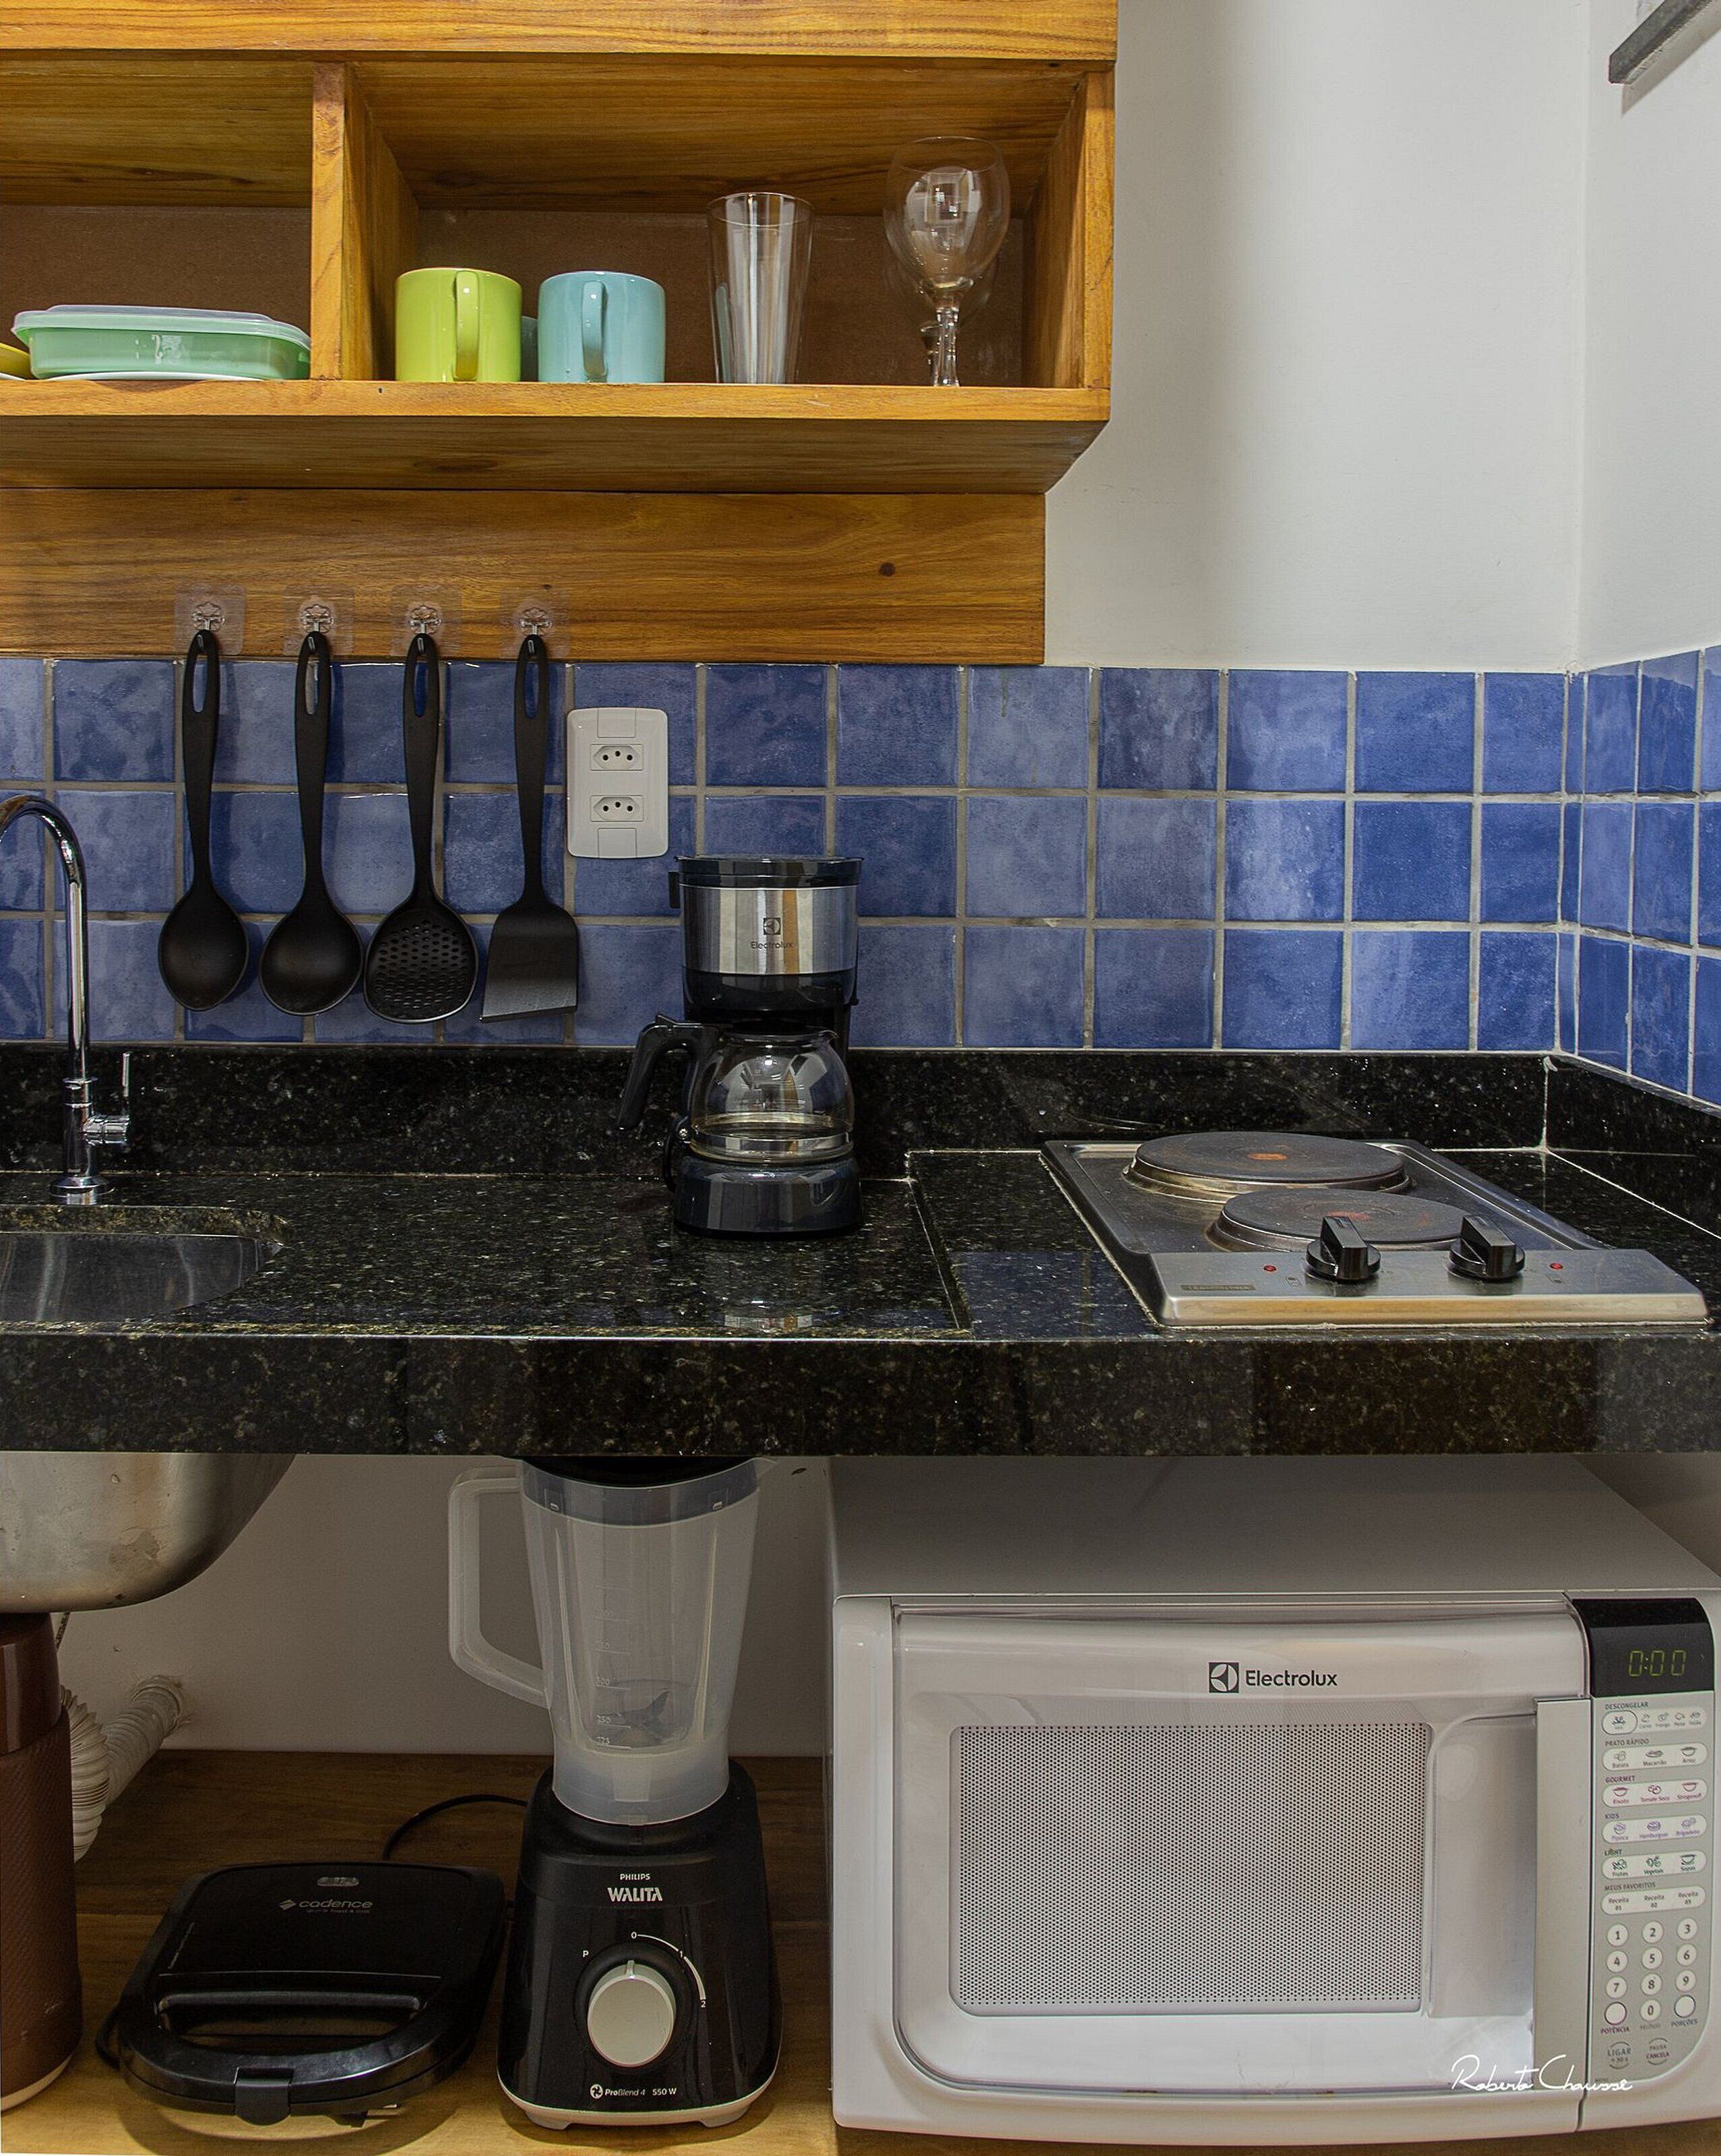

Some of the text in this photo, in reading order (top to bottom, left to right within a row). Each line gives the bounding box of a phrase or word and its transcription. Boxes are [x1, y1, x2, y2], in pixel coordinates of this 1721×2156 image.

[751, 941, 794, 949] Electrolux
[1629, 1650, 1686, 1676] 0:00
[1245, 1670, 1338, 1686] Electrolux
[1605, 1702, 1649, 1710] DESCONGELAR
[1623, 1882, 1656, 1890] FAVORITOS
[607, 1887, 663, 1901] WALITA
[299, 1898, 372, 1908] cadence
[1650, 1928, 1656, 1937] 2
[1685, 1924, 1690, 1934] 3
[1615, 1931, 1620, 1940] 1
[1650, 1954, 1655, 1963] 5
[1684, 1951, 1689, 1960] 6
[1614, 1957, 1620, 1966] 4
[1648, 1979, 1655, 1989] 8
[1683, 1975, 1689, 1986] 9
[1613, 1983, 1619, 1992] 7
[1648, 2005, 1654, 2016] 0
[1671, 2019, 1698, 2027] PORÇÕES
[1601, 2026, 1629, 2034] POTÊNCIA
[1608, 2048, 1631, 2056] LIGAR
